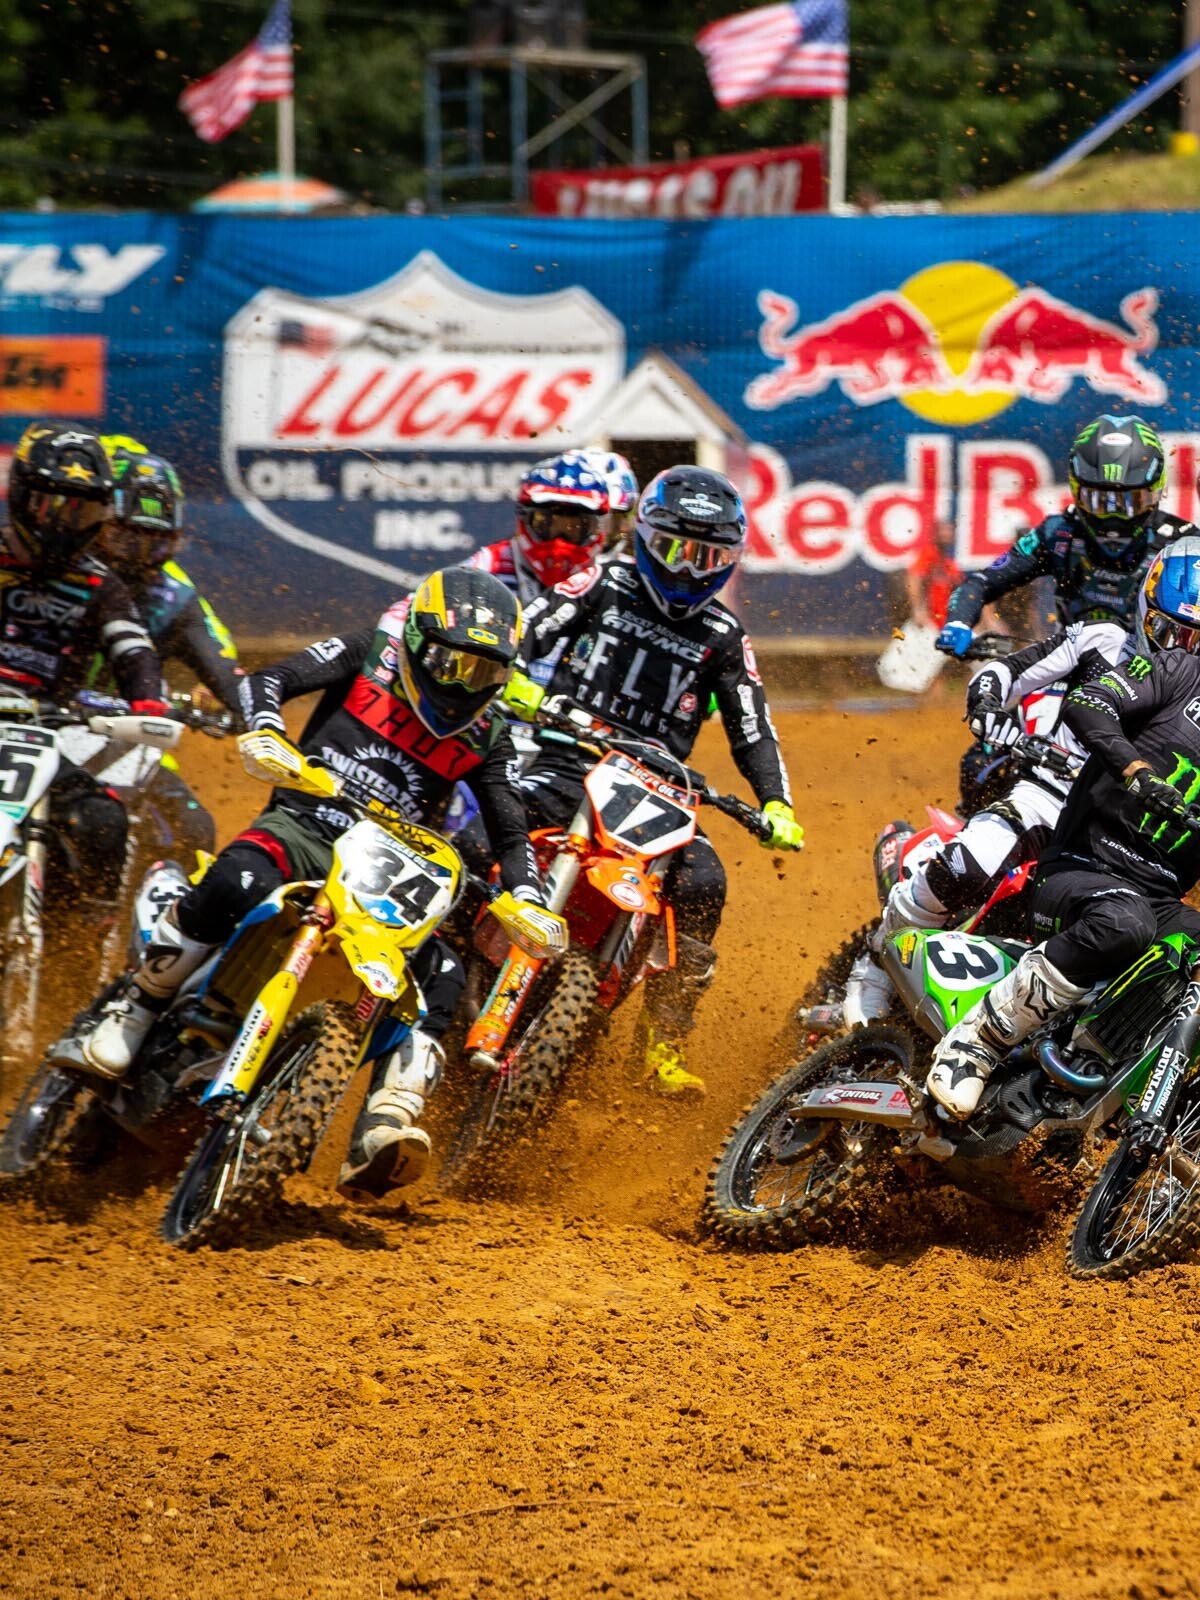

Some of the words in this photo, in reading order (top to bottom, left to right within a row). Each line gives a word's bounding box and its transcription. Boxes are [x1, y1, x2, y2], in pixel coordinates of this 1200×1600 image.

[276, 367, 594, 438] LUCAS
[247, 460, 333, 501] OIL
[373, 510, 475, 551] INC.
[622, 610, 652, 629] ROCKY
[653, 622, 707, 652] MOUNTAIN
[584, 631, 698, 714] FLY
[575, 684, 669, 734] RACING
[321, 746, 400, 799] TWISTED
[600, 781, 692, 847] 17
[1107, 841, 1145, 862] DUNLOP
[351, 846, 442, 926] 34
[926, 940, 999, 980] 3
[1141, 1045, 1175, 1113] DUNLOP
